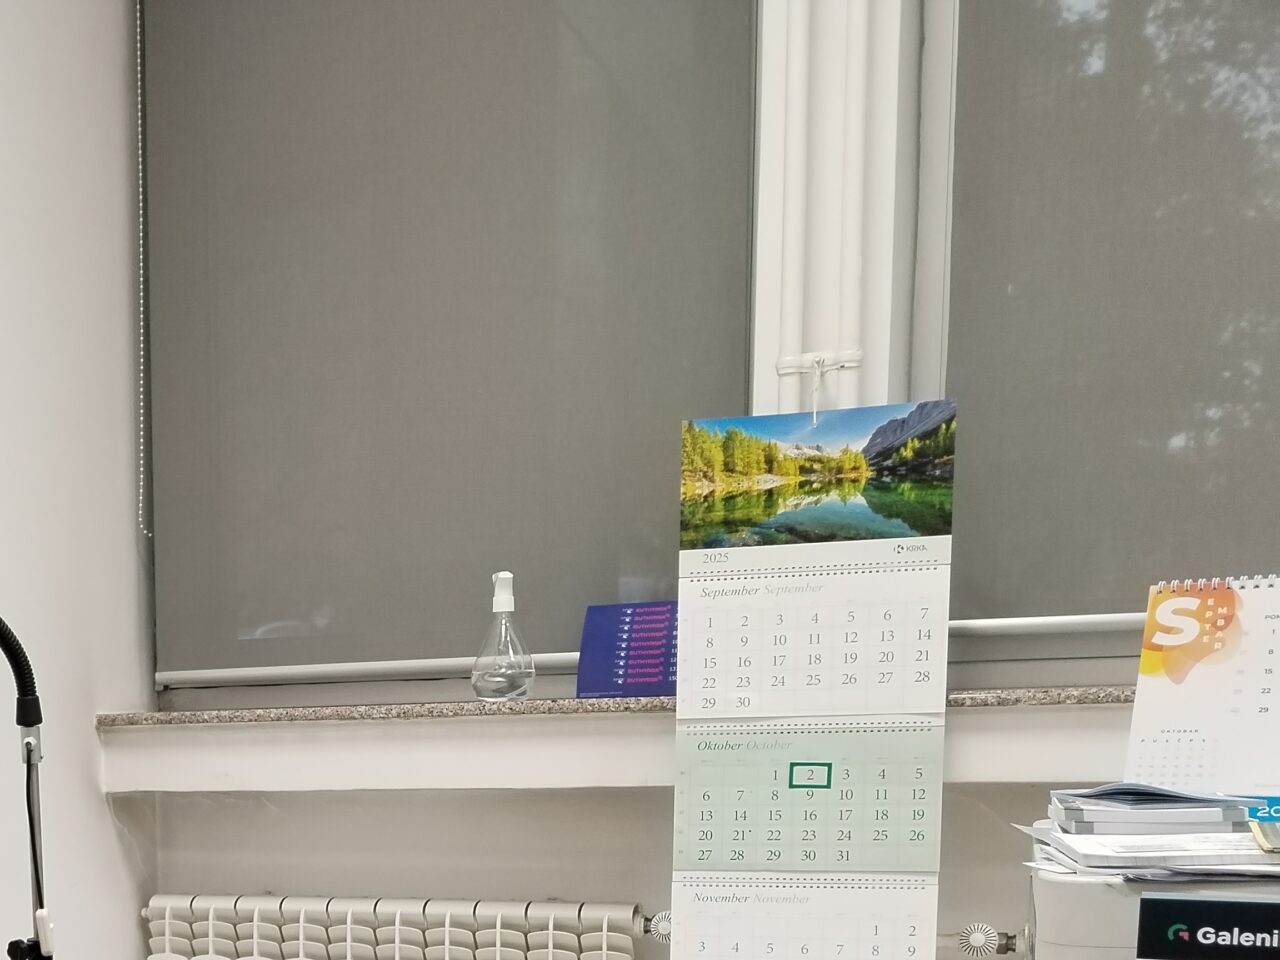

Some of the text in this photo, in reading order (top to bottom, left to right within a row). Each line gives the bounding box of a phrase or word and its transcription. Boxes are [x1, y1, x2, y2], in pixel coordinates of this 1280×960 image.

[703, 552, 729, 564] 2025
[700, 583, 824, 600] September September
[740, 615, 749, 627] 2
[775, 614, 785, 626] 3
[810, 612, 819, 624] 4
[846, 610, 856, 622] 5
[882, 610, 893, 621] 6
[920, 608, 928, 620] 7
[705, 629, 931, 648] 8 9 10 11 12 13 14
[704, 650, 929, 669] 15 16 17 18 19 20 21
[702, 670, 930, 689] 22 23 24 25 26 27 28
[702, 696, 750, 709] 29 30
[697, 739, 792, 751] Oktober October
[805, 769, 815, 780] 2
[841, 768, 851, 780] 3
[877, 768, 886, 780] 4
[915, 768, 923, 780] 5
[701, 788, 926, 801] 6 7 8 9 10 11 12
[700, 809, 925, 822] 13 14 15 16 17 18 19
[699, 830, 925, 841] 20 21 22 23 24 25 26
[698, 850, 849, 862] 27 28 29 30 31
[693, 892, 810, 904] November November
[908, 925, 917, 936] 2
[698, 941, 917, 957] 3 4 5 6 7 8 9
